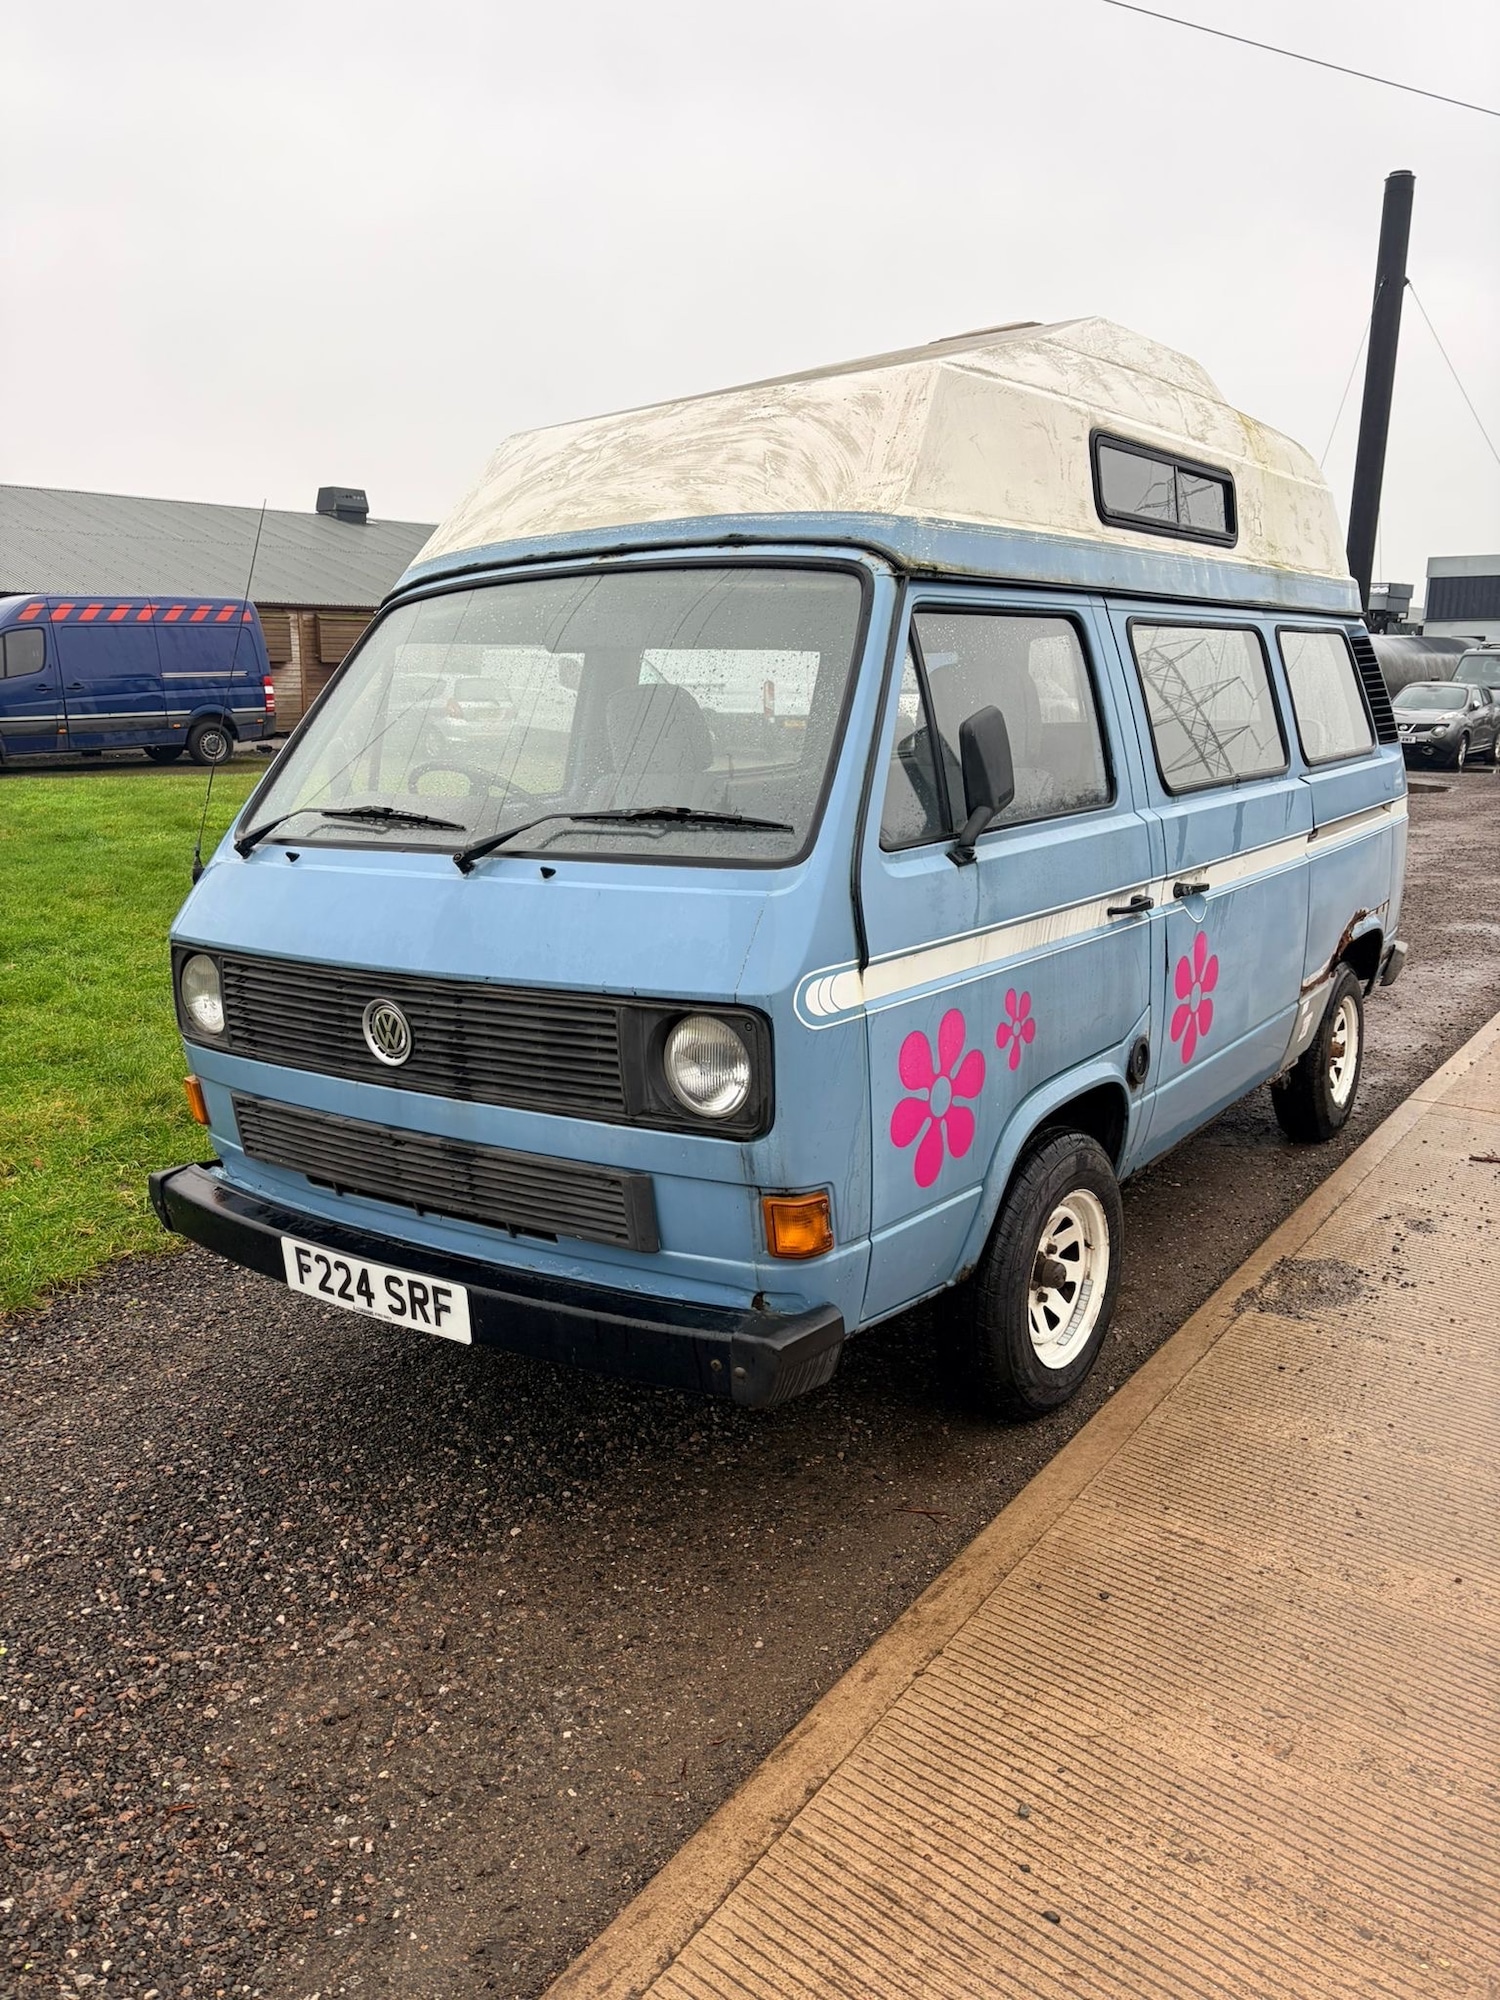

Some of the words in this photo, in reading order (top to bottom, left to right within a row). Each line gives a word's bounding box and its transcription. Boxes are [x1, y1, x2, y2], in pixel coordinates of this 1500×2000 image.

[374, 1008, 406, 1054] VW
[295, 1247, 375, 1308] F224
[384, 1275, 452, 1327] SRF
